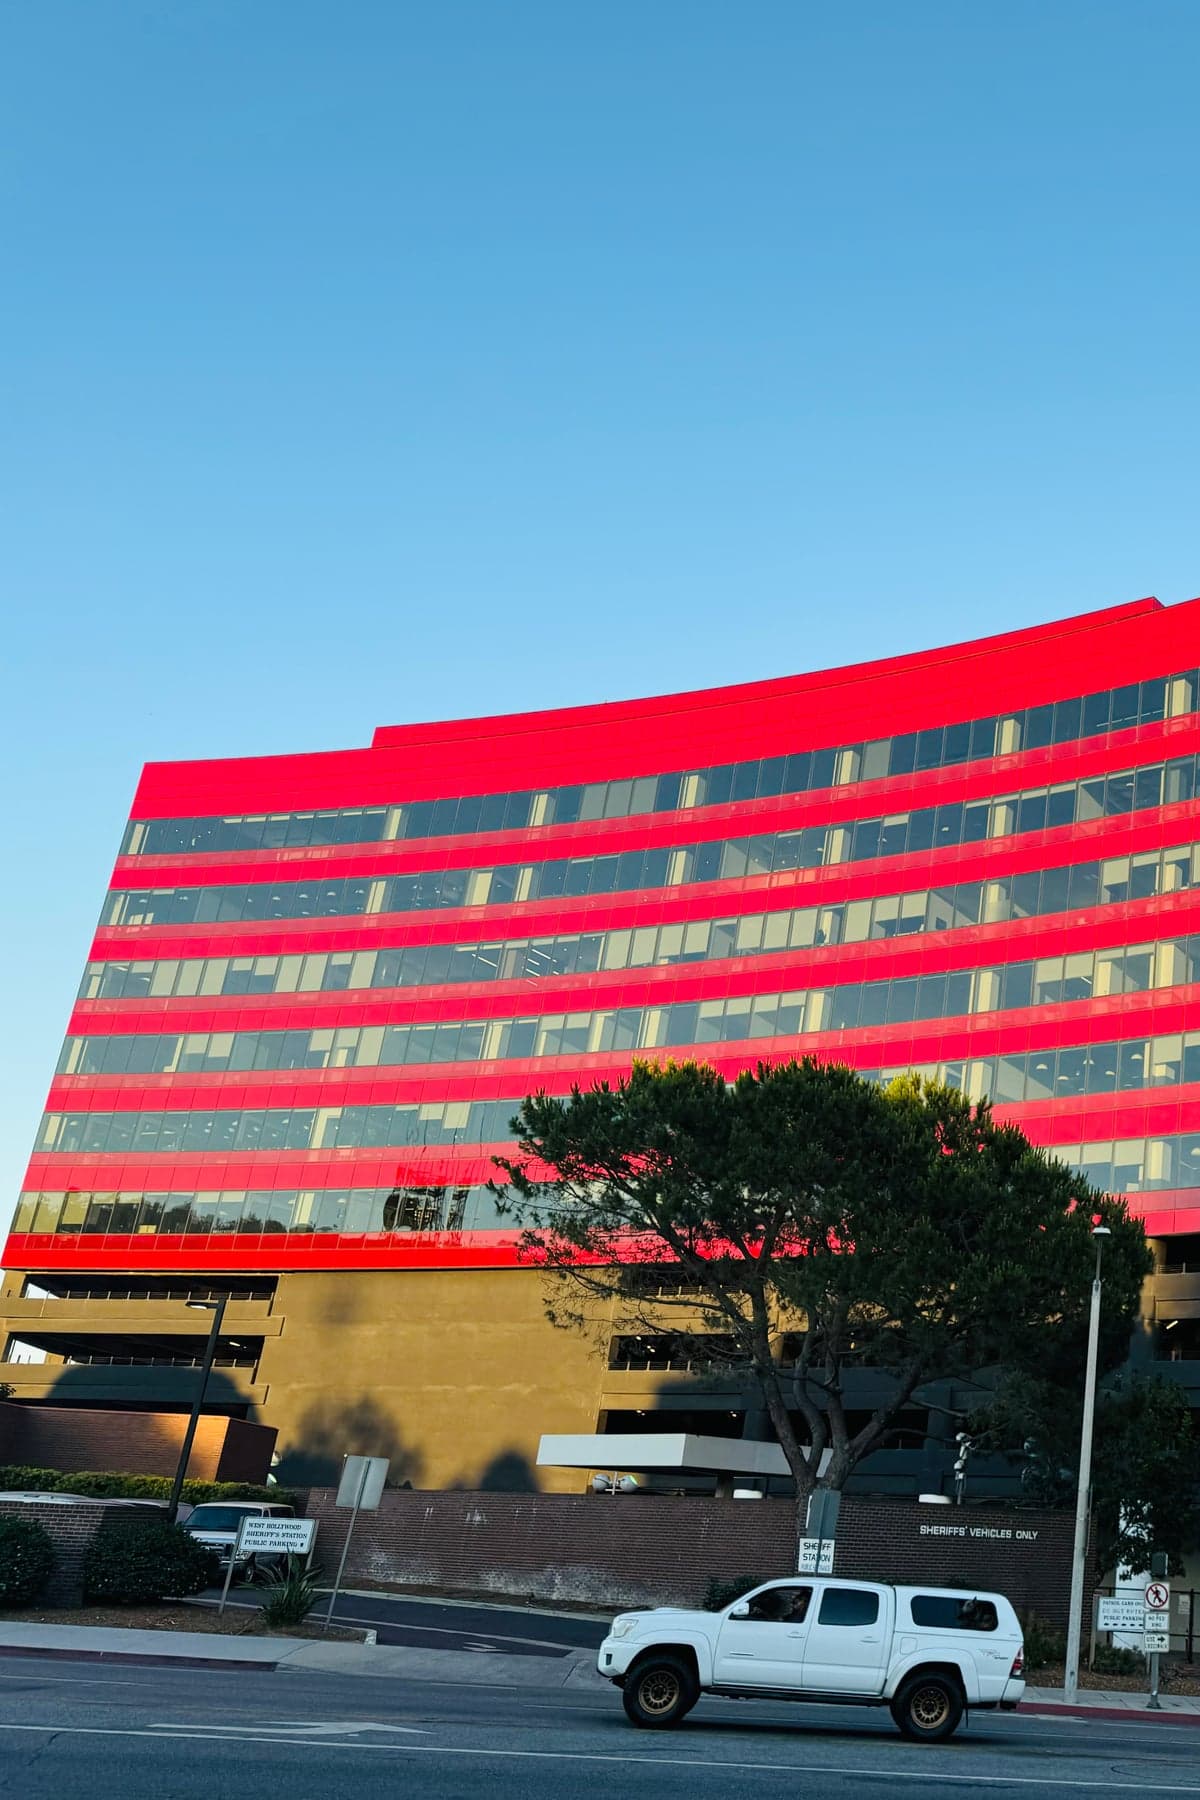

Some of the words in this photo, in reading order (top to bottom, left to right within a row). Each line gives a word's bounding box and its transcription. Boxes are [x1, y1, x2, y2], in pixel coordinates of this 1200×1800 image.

[246, 1530, 280, 1538] SHERIFF'S
[969, 1527, 1012, 1539] VEHICLES
[1015, 1530, 1039, 1540] ONLY
[802, 1553, 831, 1562] STAON
